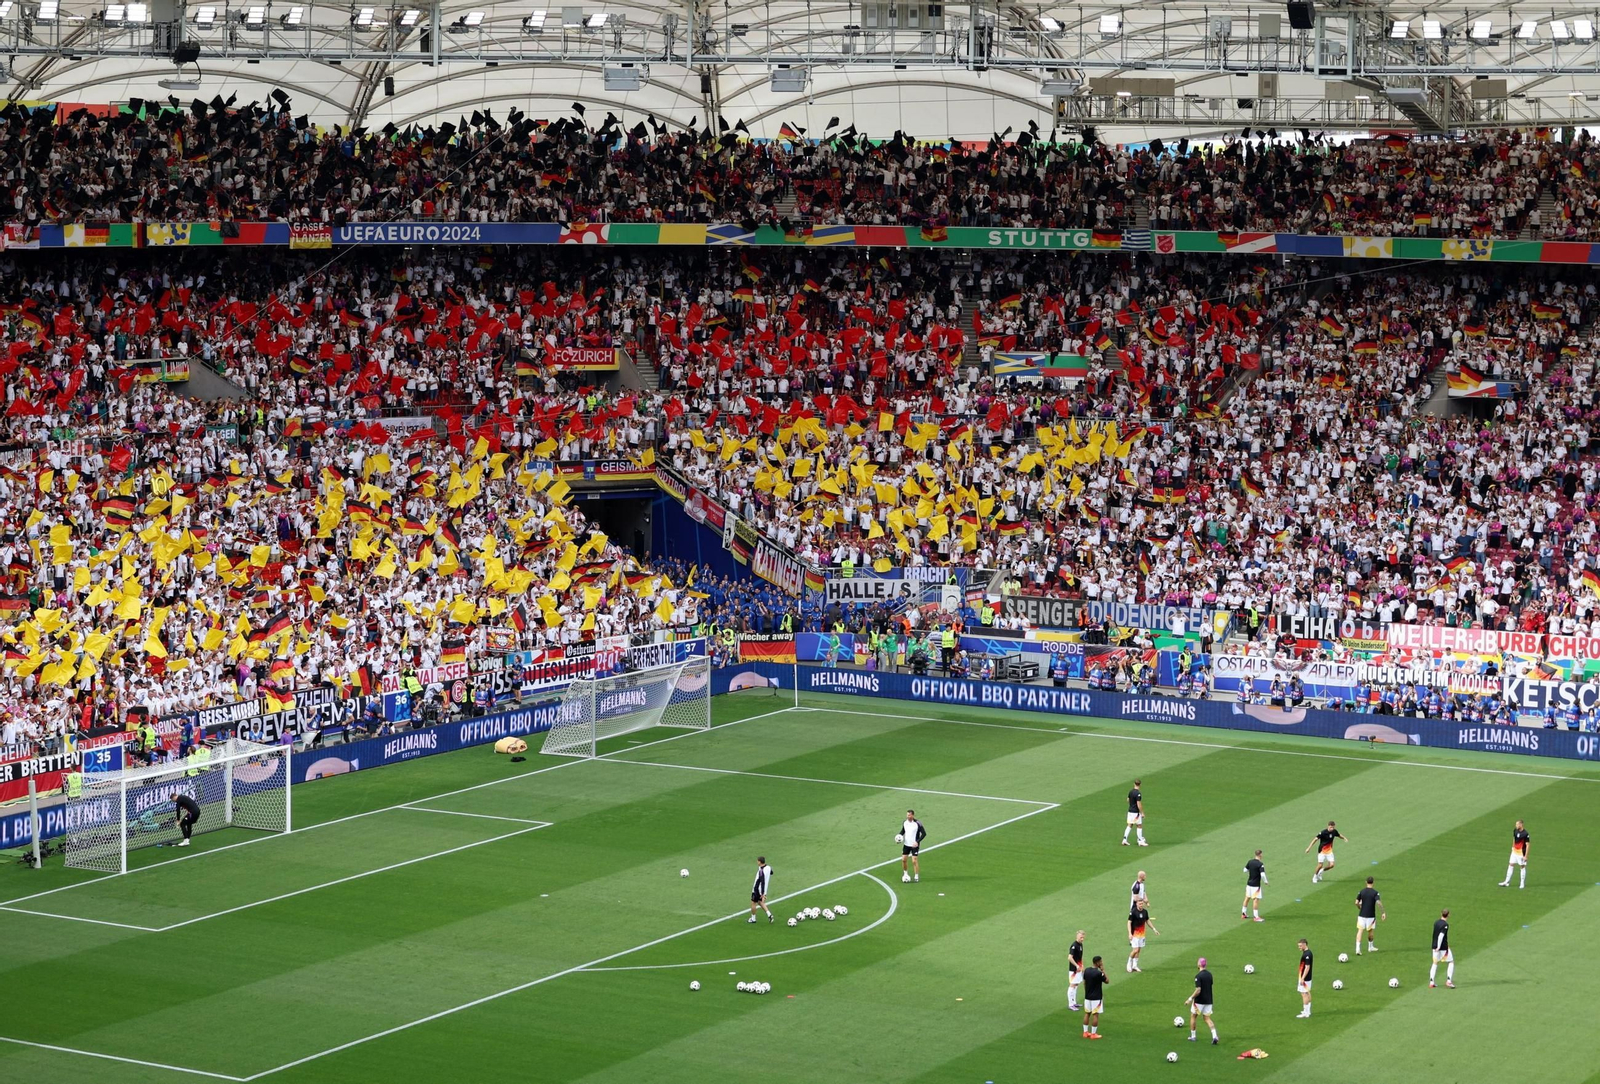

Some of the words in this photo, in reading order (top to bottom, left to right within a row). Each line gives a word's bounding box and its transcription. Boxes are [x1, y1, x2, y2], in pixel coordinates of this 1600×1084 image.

[987, 230, 1091, 248] STUTTG
[571, 348, 613, 362] ZÜRICH
[755, 539, 805, 598] RATINGEN
[828, 581, 886, 600] HALLE
[1005, 599, 1073, 627] SPENGE
[1091, 600, 1213, 633] DUDENHOEN
[684, 642, 697, 653] 37
[772, 632, 794, 642] away
[1041, 640, 1084, 655] RODDE
[566, 643, 596, 656] Ostheim
[1216, 656, 1268, 673] OSTALB
[1307, 664, 1356, 683] ADLER
[1357, 665, 1450, 687] HOCKENHEIM
[383, 676, 401, 694] BA
[811, 671, 880, 692] HELLMANN'S
[394, 694, 408, 705] 36
[911, 677, 977, 702] OFFICIAL
[981, 683, 1014, 706] BBQ
[1017, 687, 1092, 713] PARTNER
[1503, 678, 1600, 713] KETSC
[1121, 698, 1196, 721] HELLMANN'S
[460, 713, 507, 744] OFFICIAL
[510, 707, 531, 735] BBQ
[534, 703, 582, 728] PARTNER
[384, 728, 438, 760] HELLMANN'S
[1458, 727, 1540, 751] HELLMANN'S
[21, 750, 80, 778] BRETTEN
[97, 750, 113, 765] 35
[13, 813, 43, 838] BBQ
[46, 799, 111, 830] PARTNER
